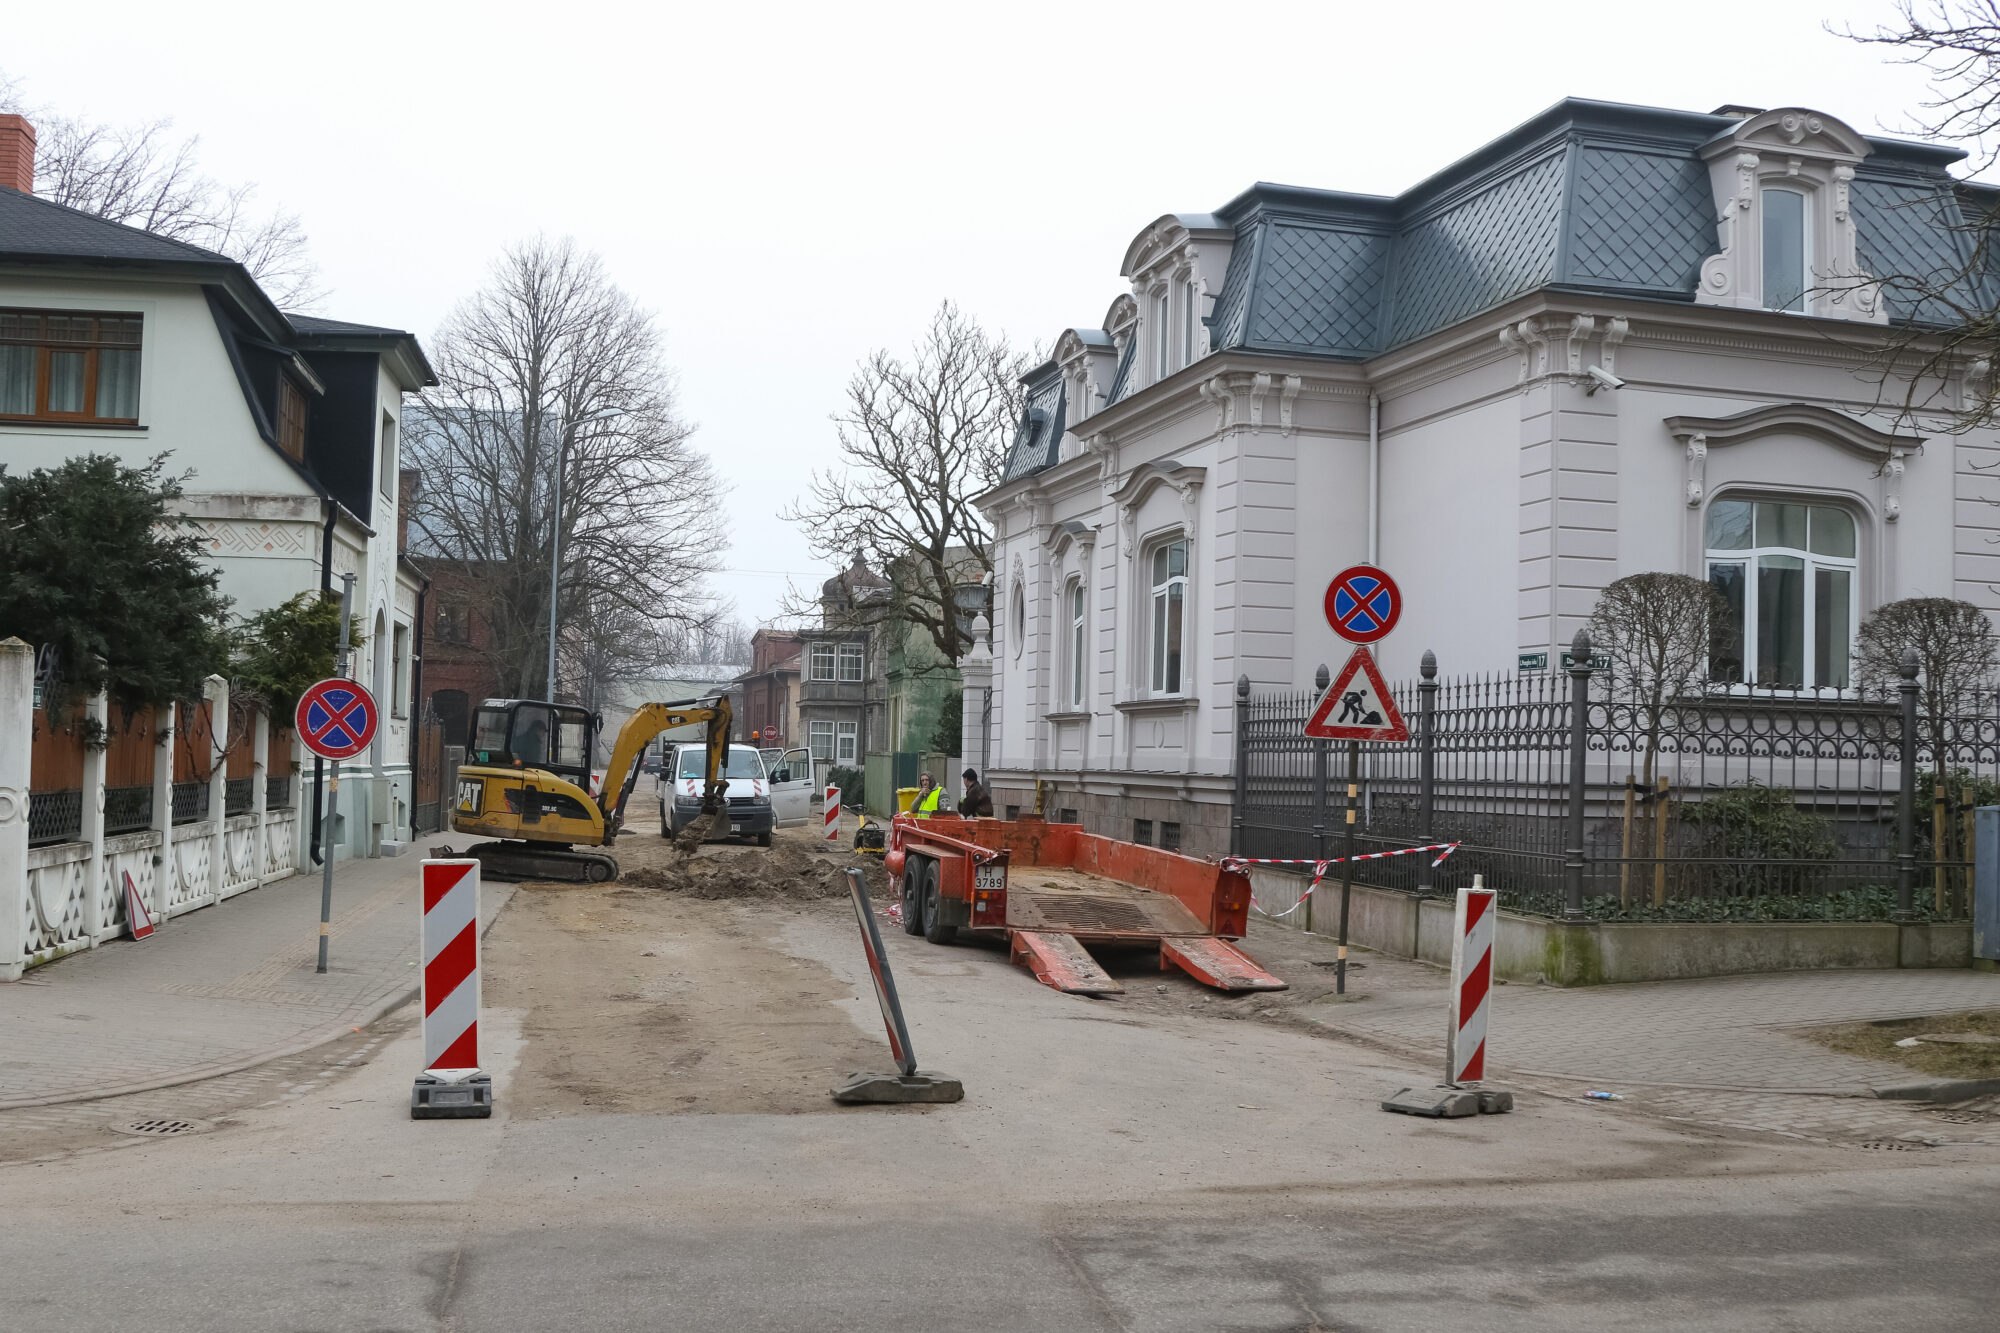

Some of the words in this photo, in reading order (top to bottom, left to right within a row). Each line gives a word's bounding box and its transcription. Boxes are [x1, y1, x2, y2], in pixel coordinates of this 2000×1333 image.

[1538, 655, 1546, 667] 17
[1597, 656, 1610, 668] 17
[671, 716, 681, 725] CAT
[456, 781, 482, 812] CAT
[984, 866, 992, 877] H
[975, 878, 1003, 888] 3789
